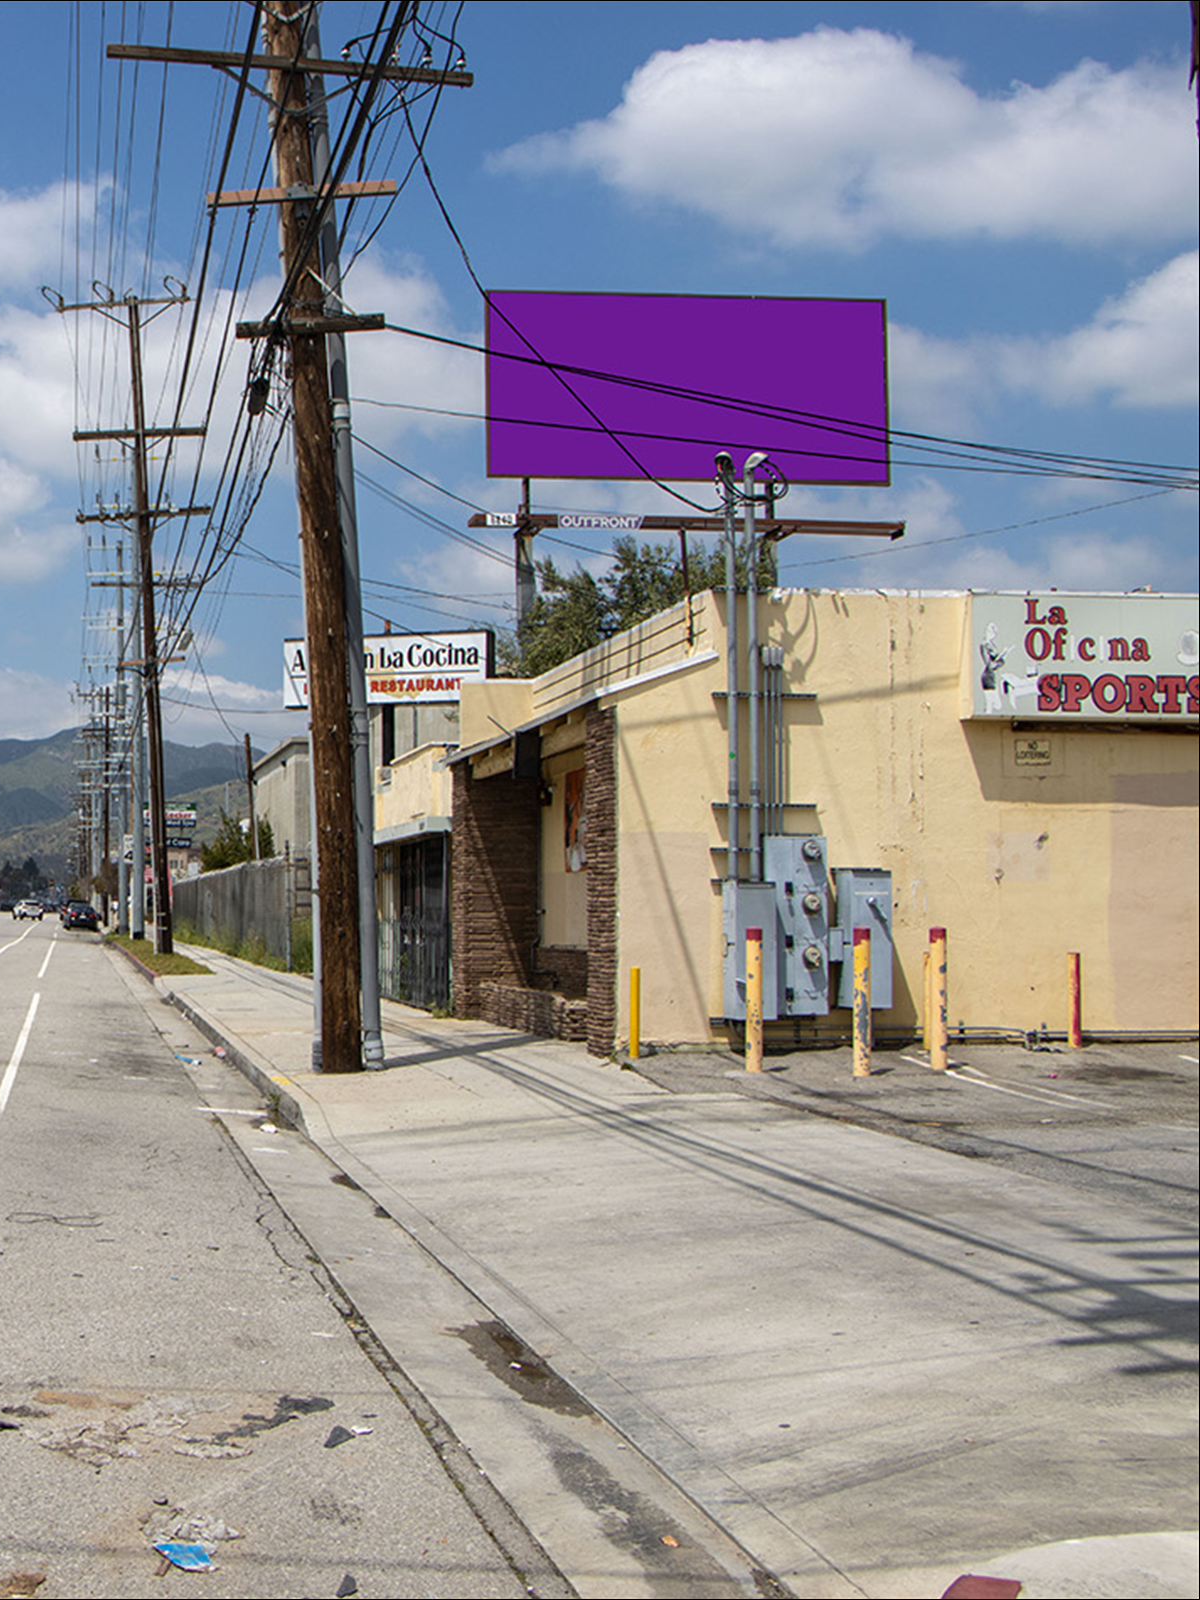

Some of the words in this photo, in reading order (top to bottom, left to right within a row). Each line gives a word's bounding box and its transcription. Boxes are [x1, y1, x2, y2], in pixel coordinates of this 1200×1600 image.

[560, 515, 638, 528] OUTFRONT
[1024, 599, 1068, 625] La
[1024, 627, 1151, 661] Ofcna
[380, 646, 404, 669] La
[407, 642, 479, 668] Cocina
[370, 677, 461, 693] RESTAURANT
[1027, 740, 1039, 750] NO
[1015, 750, 1050, 760] LOITERING
